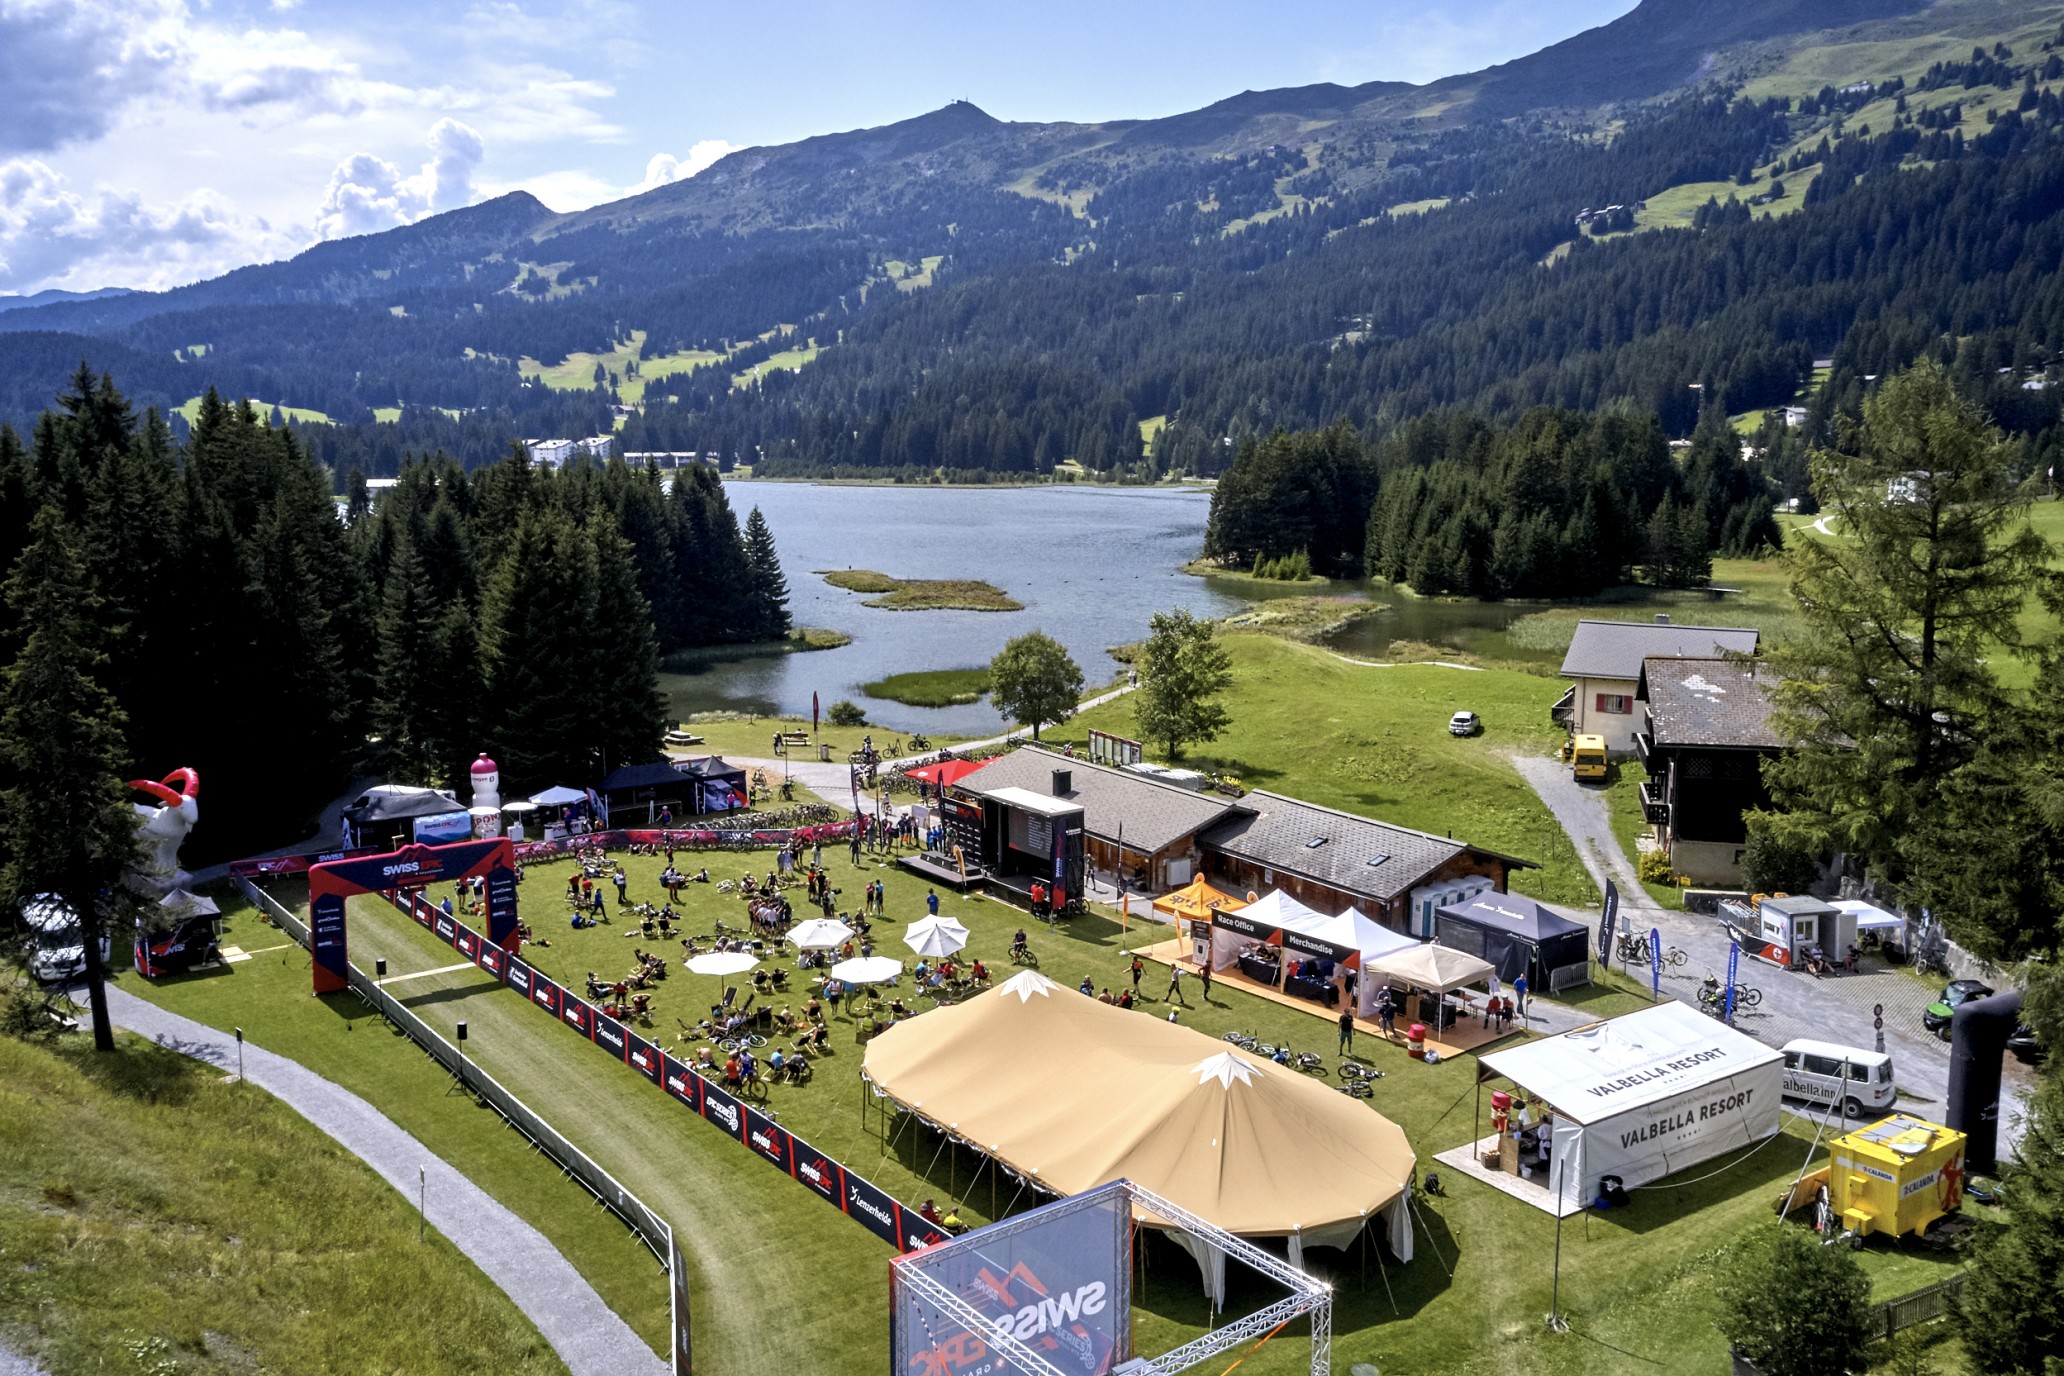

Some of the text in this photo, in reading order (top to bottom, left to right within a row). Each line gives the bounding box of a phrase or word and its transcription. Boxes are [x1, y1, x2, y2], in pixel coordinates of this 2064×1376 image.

[318, 852, 345, 862] SWISS
[383, 861, 420, 876] SWISS
[1217, 914, 1255, 932] Race Office
[1289, 934, 1334, 956] Merchandise
[1586, 1065, 1671, 1098] VALBELLA
[1667, 1047, 1727, 1072] RESORT
[1620, 1110, 1695, 1149] VALBELLA
[1699, 1089, 1754, 1121] RESORT
[752, 1131, 771, 1150] SWISS
[800, 1162, 821, 1182] SWISS
[1868, 1168, 1893, 1182] CALANDA
[1908, 1174, 1934, 1194] CALANDA
[856, 1195, 892, 1227] Lenzerheide
